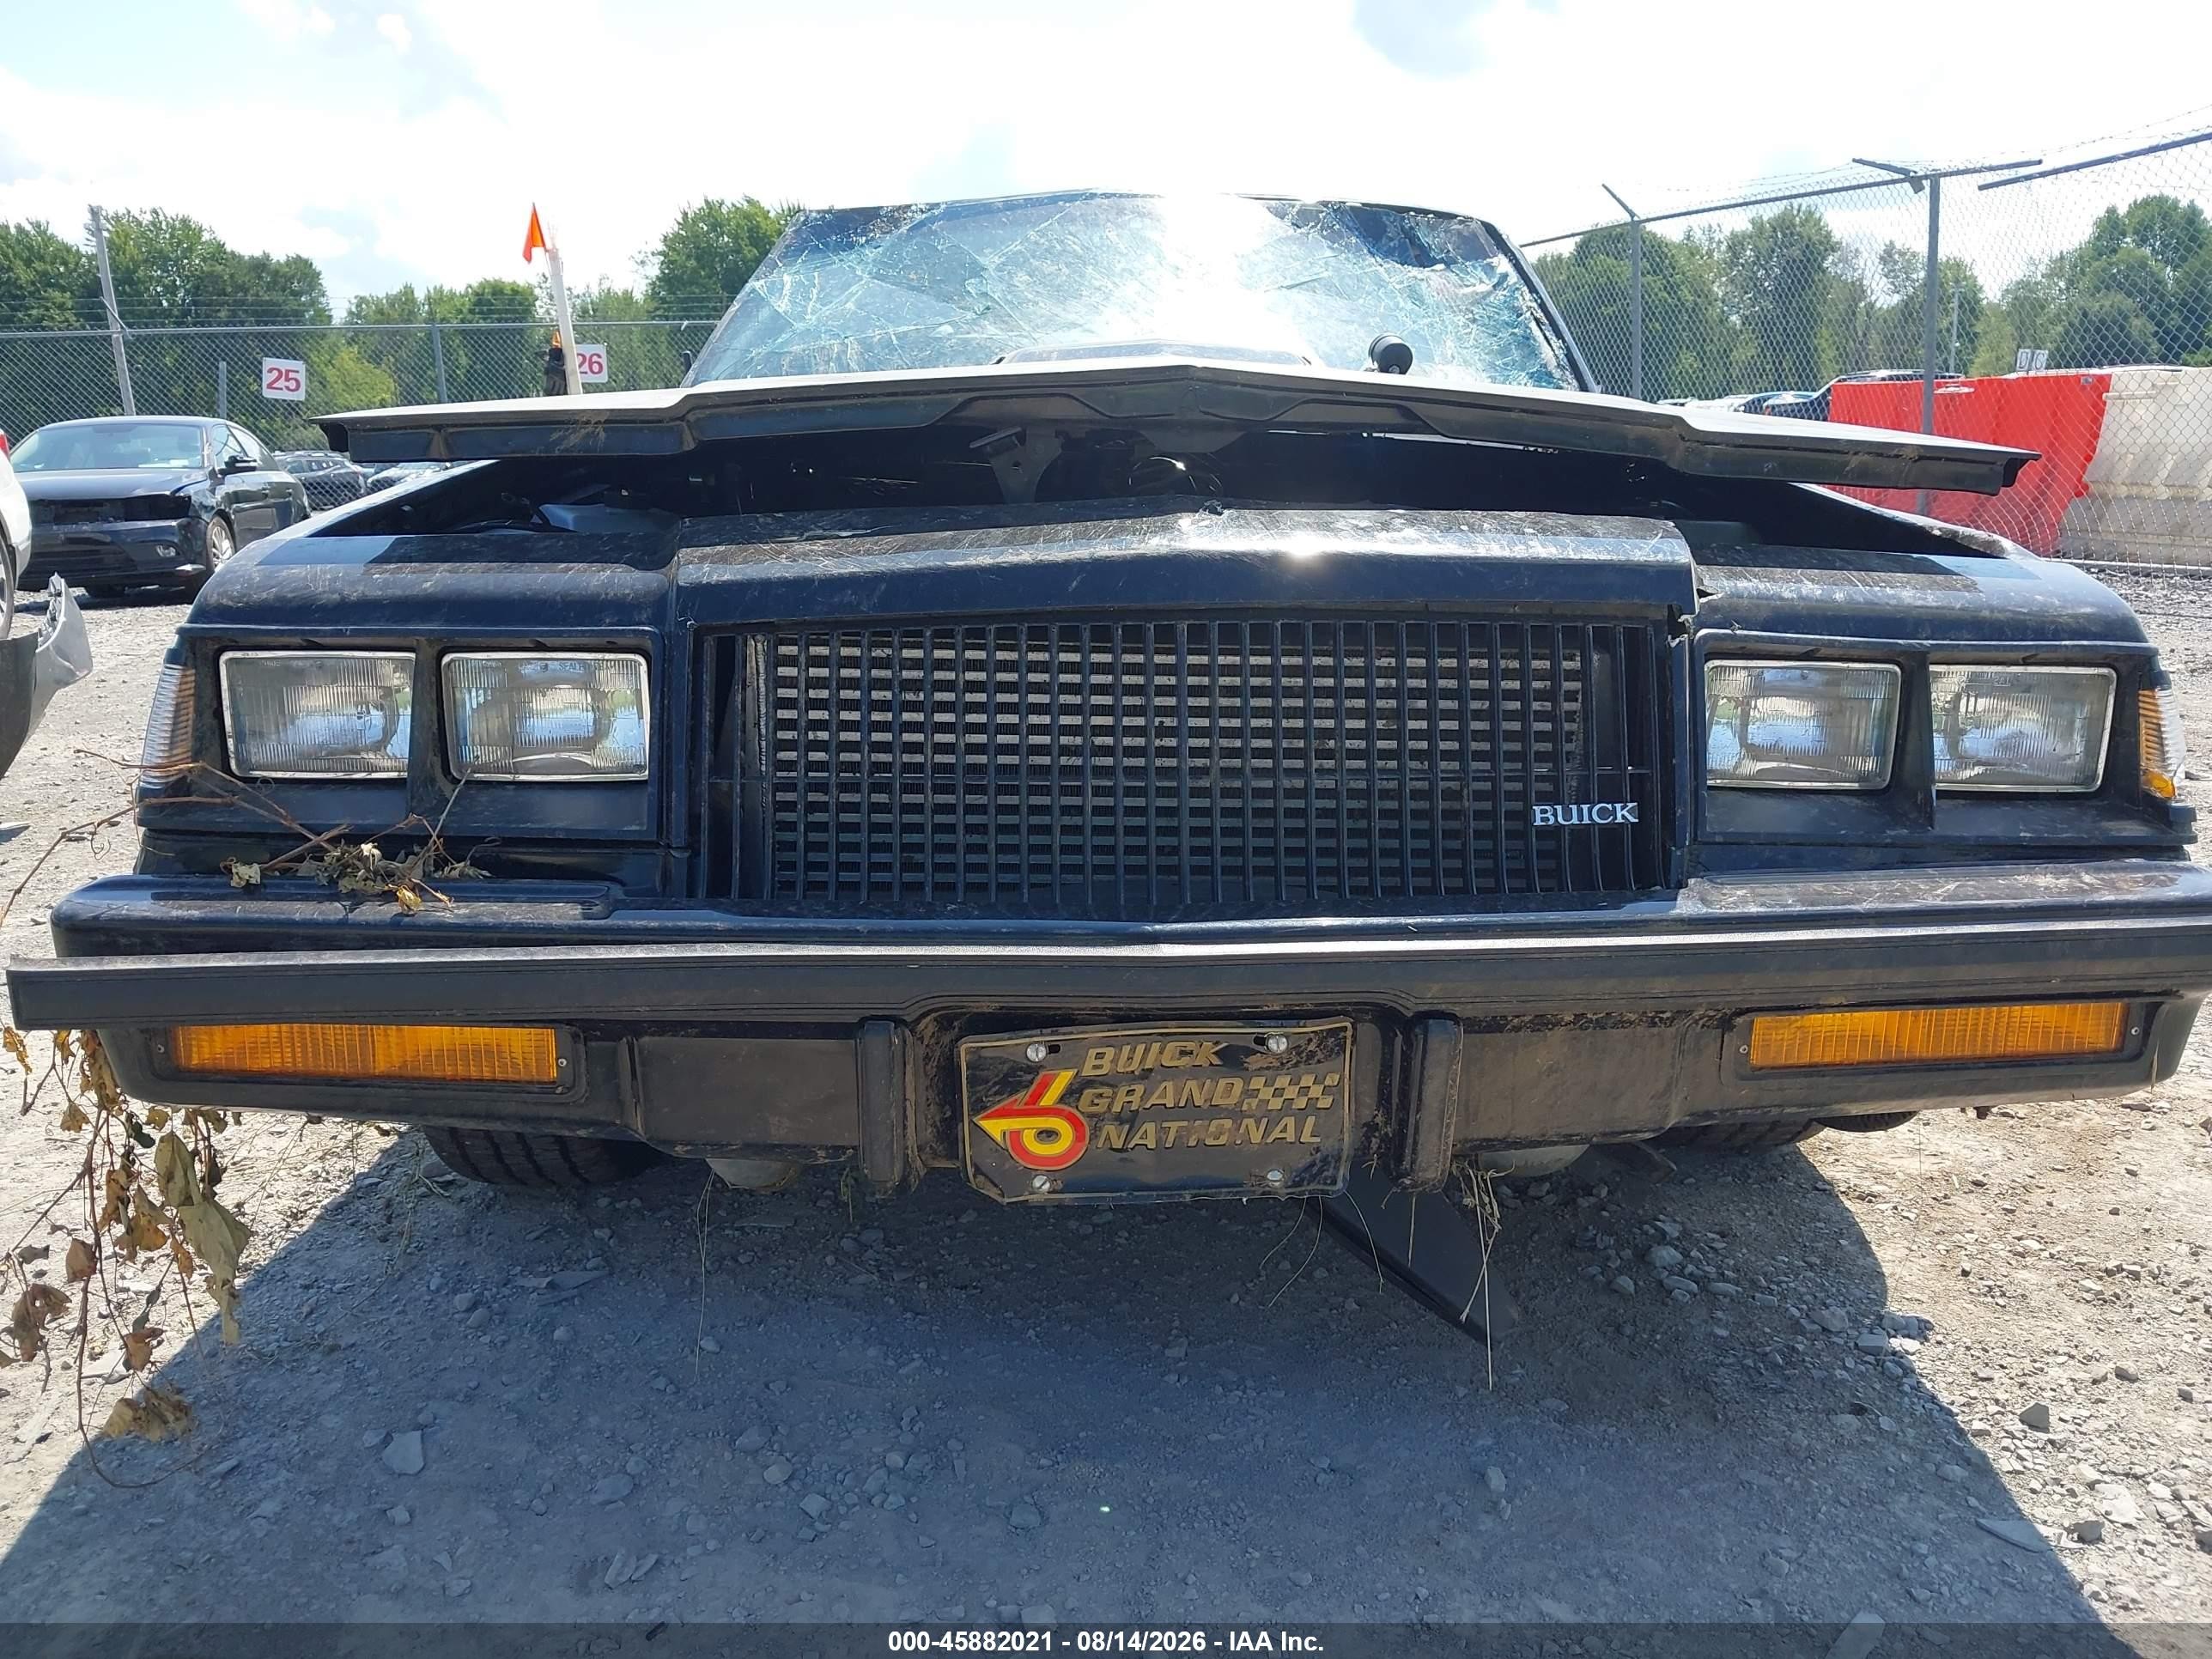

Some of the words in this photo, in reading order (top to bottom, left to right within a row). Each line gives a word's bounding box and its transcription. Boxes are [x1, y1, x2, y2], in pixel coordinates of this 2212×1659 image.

[576, 353, 604, 375] 26
[266, 367, 301, 392] 25
[1532, 802, 1639, 826] BUICK
[1081, 1041, 1230, 1077] BUICK
[1078, 1077, 1244, 1114] GRAND
[1097, 1115, 1322, 1150] NATIONAL
